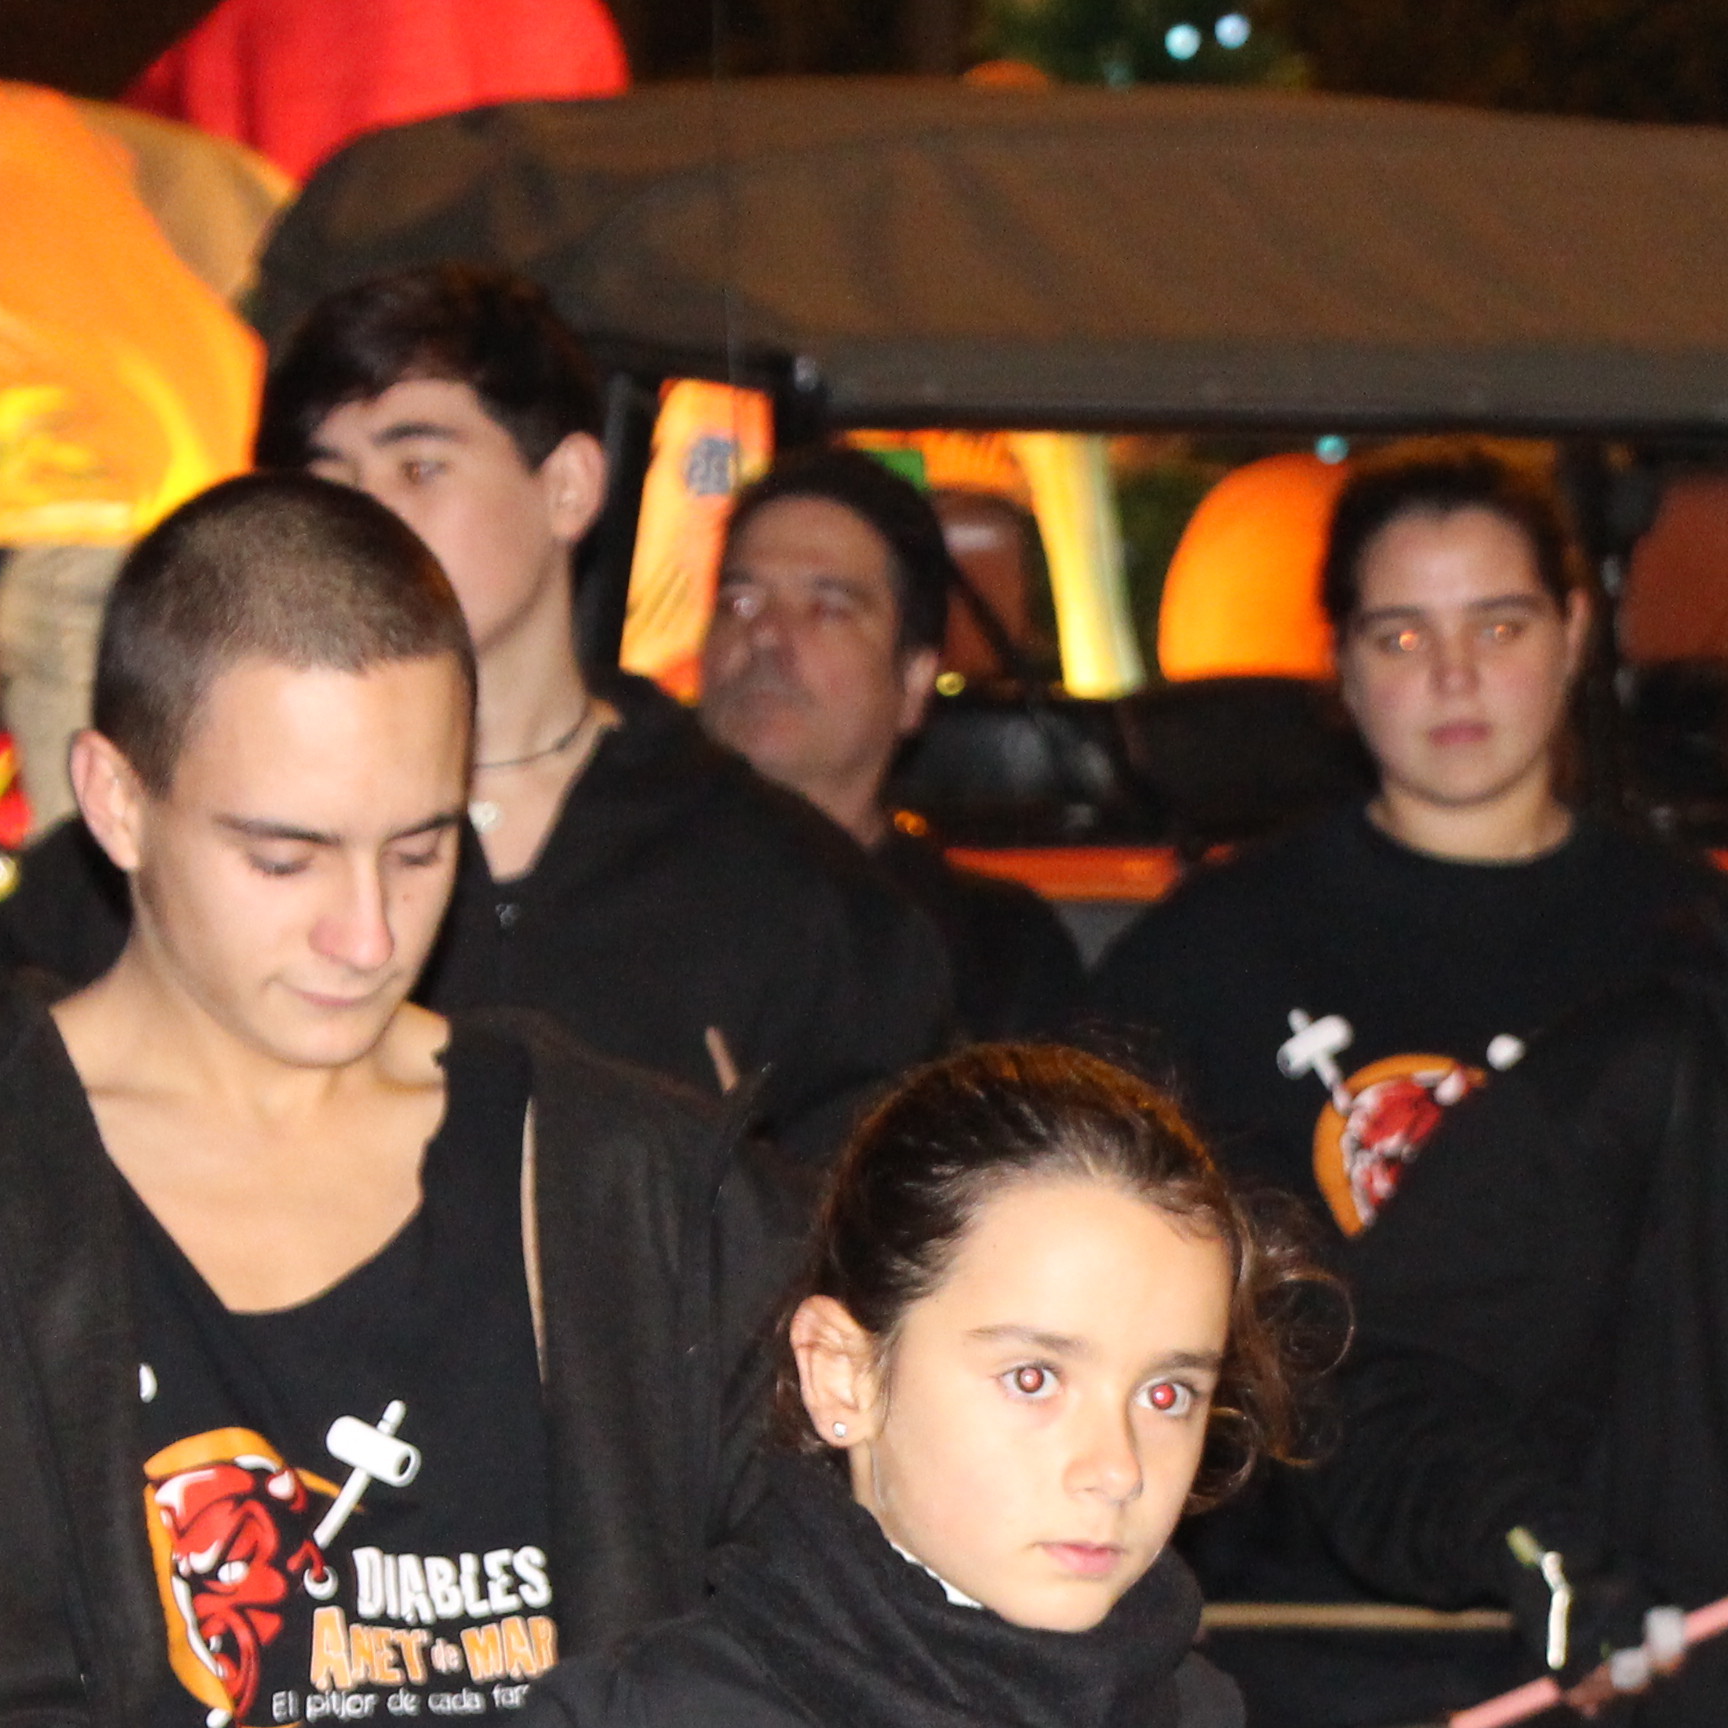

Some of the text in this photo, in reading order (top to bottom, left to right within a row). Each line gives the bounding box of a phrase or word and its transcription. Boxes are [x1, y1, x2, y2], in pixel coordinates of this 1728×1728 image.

[352, 1546, 553, 1624] DIABLES
[431, 1637, 464, 1675] de
[460, 1615, 559, 1684] MAR
[272, 1690, 299, 1722] El
[306, 1690, 378, 1723] pitjor
[387, 1687, 421, 1716] de
[428, 1687, 486, 1716] cada
